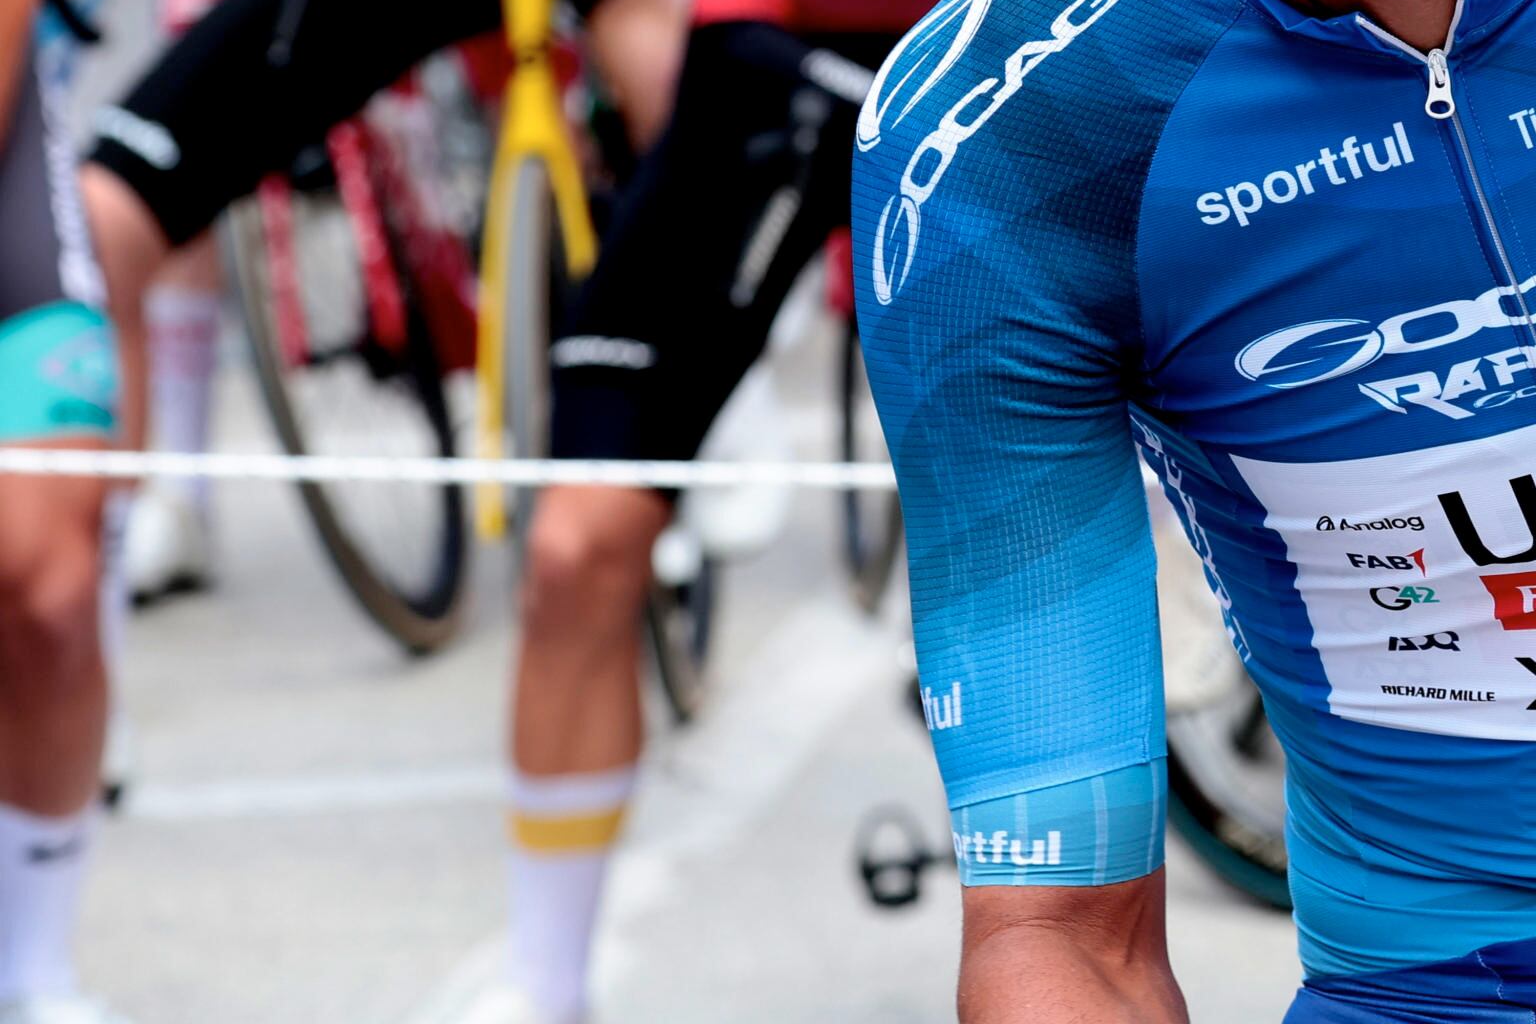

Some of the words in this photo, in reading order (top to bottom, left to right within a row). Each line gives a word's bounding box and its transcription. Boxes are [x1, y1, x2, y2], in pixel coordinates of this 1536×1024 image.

[1196, 121, 1415, 227] sportful
[1340, 516, 1425, 531] Analog
[1369, 586, 1440, 611] G42
[920, 681, 961, 730] ful
[1381, 685, 1447, 700] RICHARD
[1450, 689, 1496, 702] MILLE
